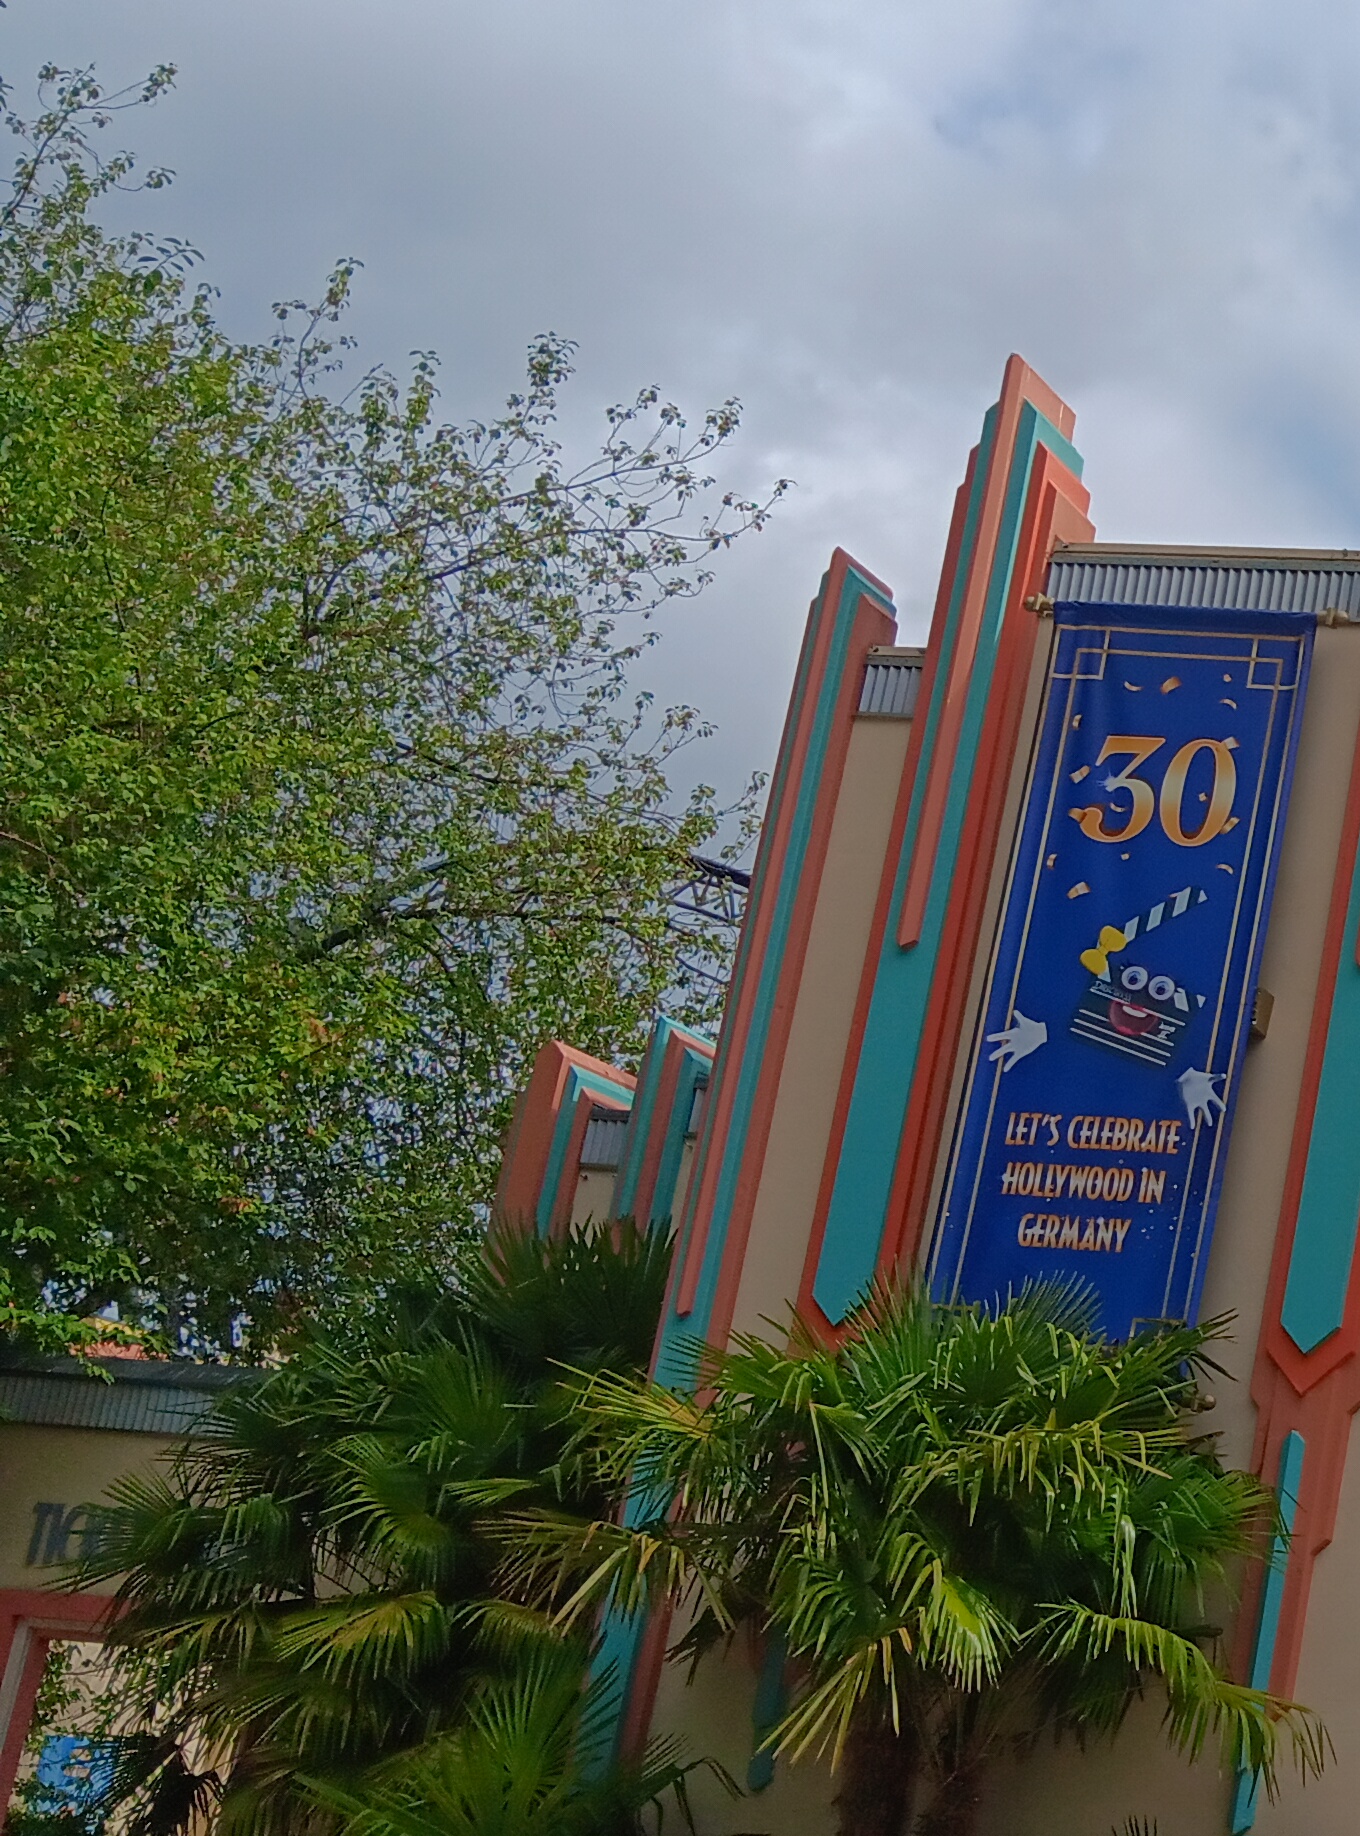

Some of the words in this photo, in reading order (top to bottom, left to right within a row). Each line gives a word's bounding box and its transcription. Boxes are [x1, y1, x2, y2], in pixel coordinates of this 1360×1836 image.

[1078, 735, 1237, 847] 30
[1004, 1112, 1062, 1146] LET'S
[1067, 1115, 1182, 1154] CELEBRATE
[1001, 1162, 1134, 1202] HOLLYWOOD
[1137, 1168, 1167, 1204] IN
[1017, 1213, 1132, 1253] GERMANY
